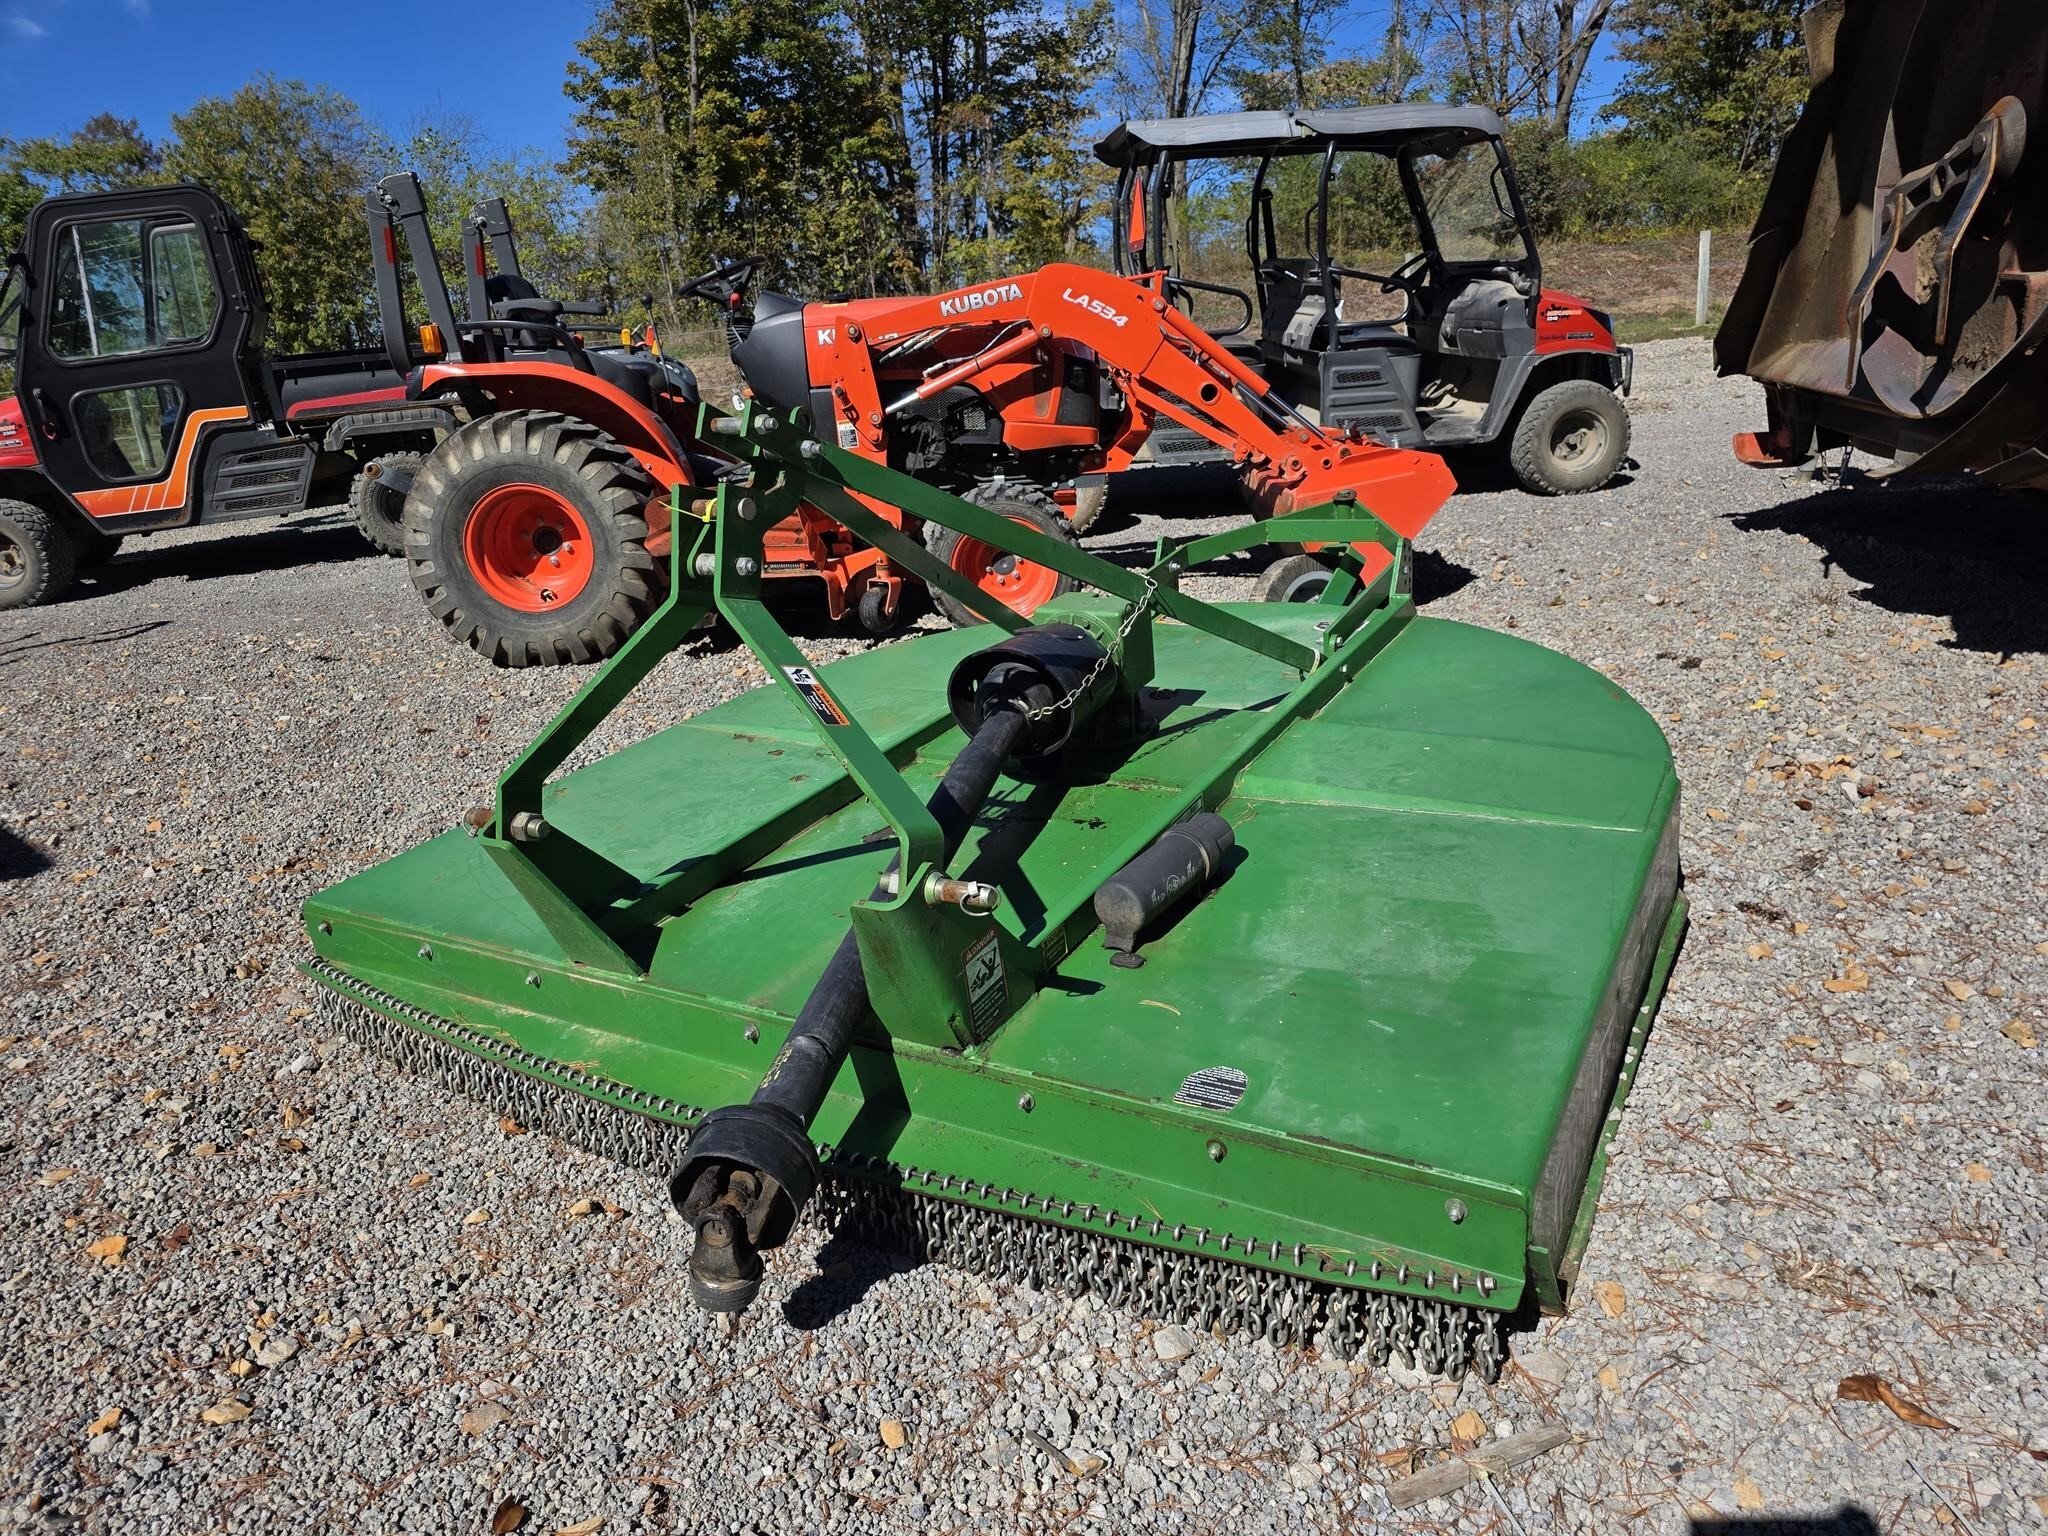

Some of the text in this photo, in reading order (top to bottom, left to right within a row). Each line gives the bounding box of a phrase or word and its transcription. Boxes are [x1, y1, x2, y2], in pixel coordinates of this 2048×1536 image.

[940, 283, 1024, 317] KUBOTA
[1062, 287, 1129, 327] LA534
[971, 928, 996, 954] DANGER
